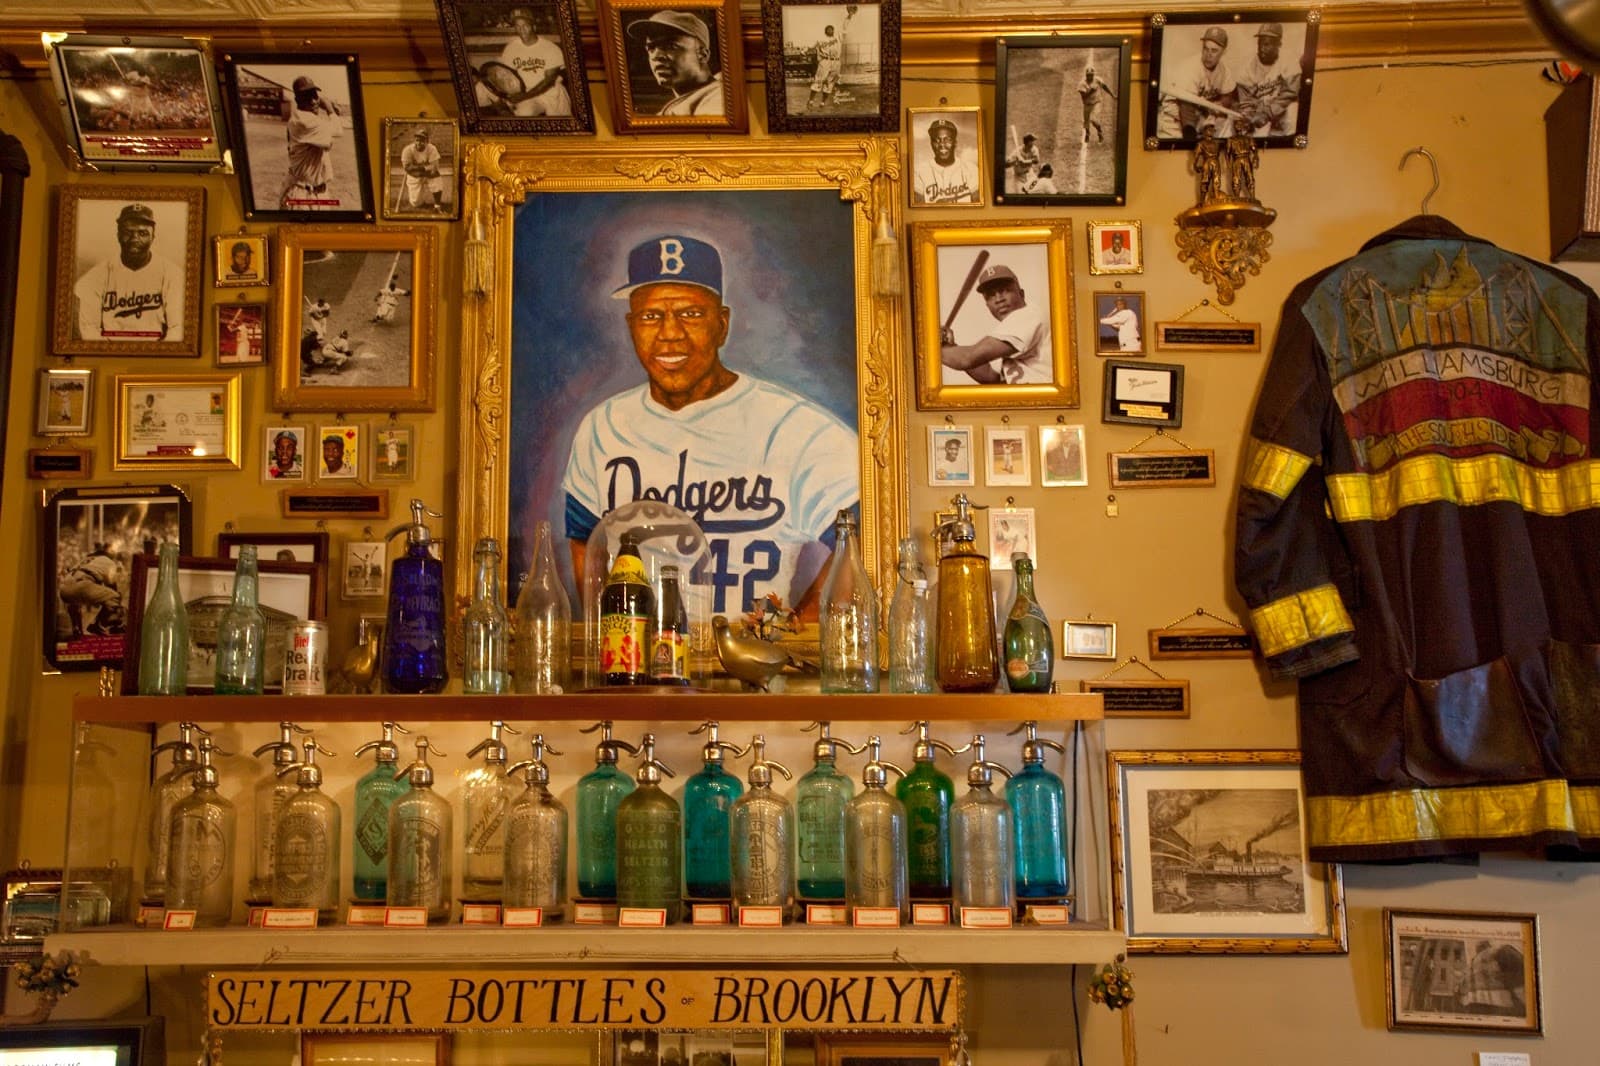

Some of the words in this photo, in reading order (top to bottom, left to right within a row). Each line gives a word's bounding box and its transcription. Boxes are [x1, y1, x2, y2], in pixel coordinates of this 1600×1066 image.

[659, 238, 686, 275] B
[1355, 351, 1561, 400] WILLIAMSBURG
[603, 449, 786, 533] Dodgers
[689, 538, 782, 613] 42
[212, 978, 412, 1026] SELTZER
[443, 978, 667, 1024] BOTTLES
[709, 976, 951, 1024] BROOKLYN
